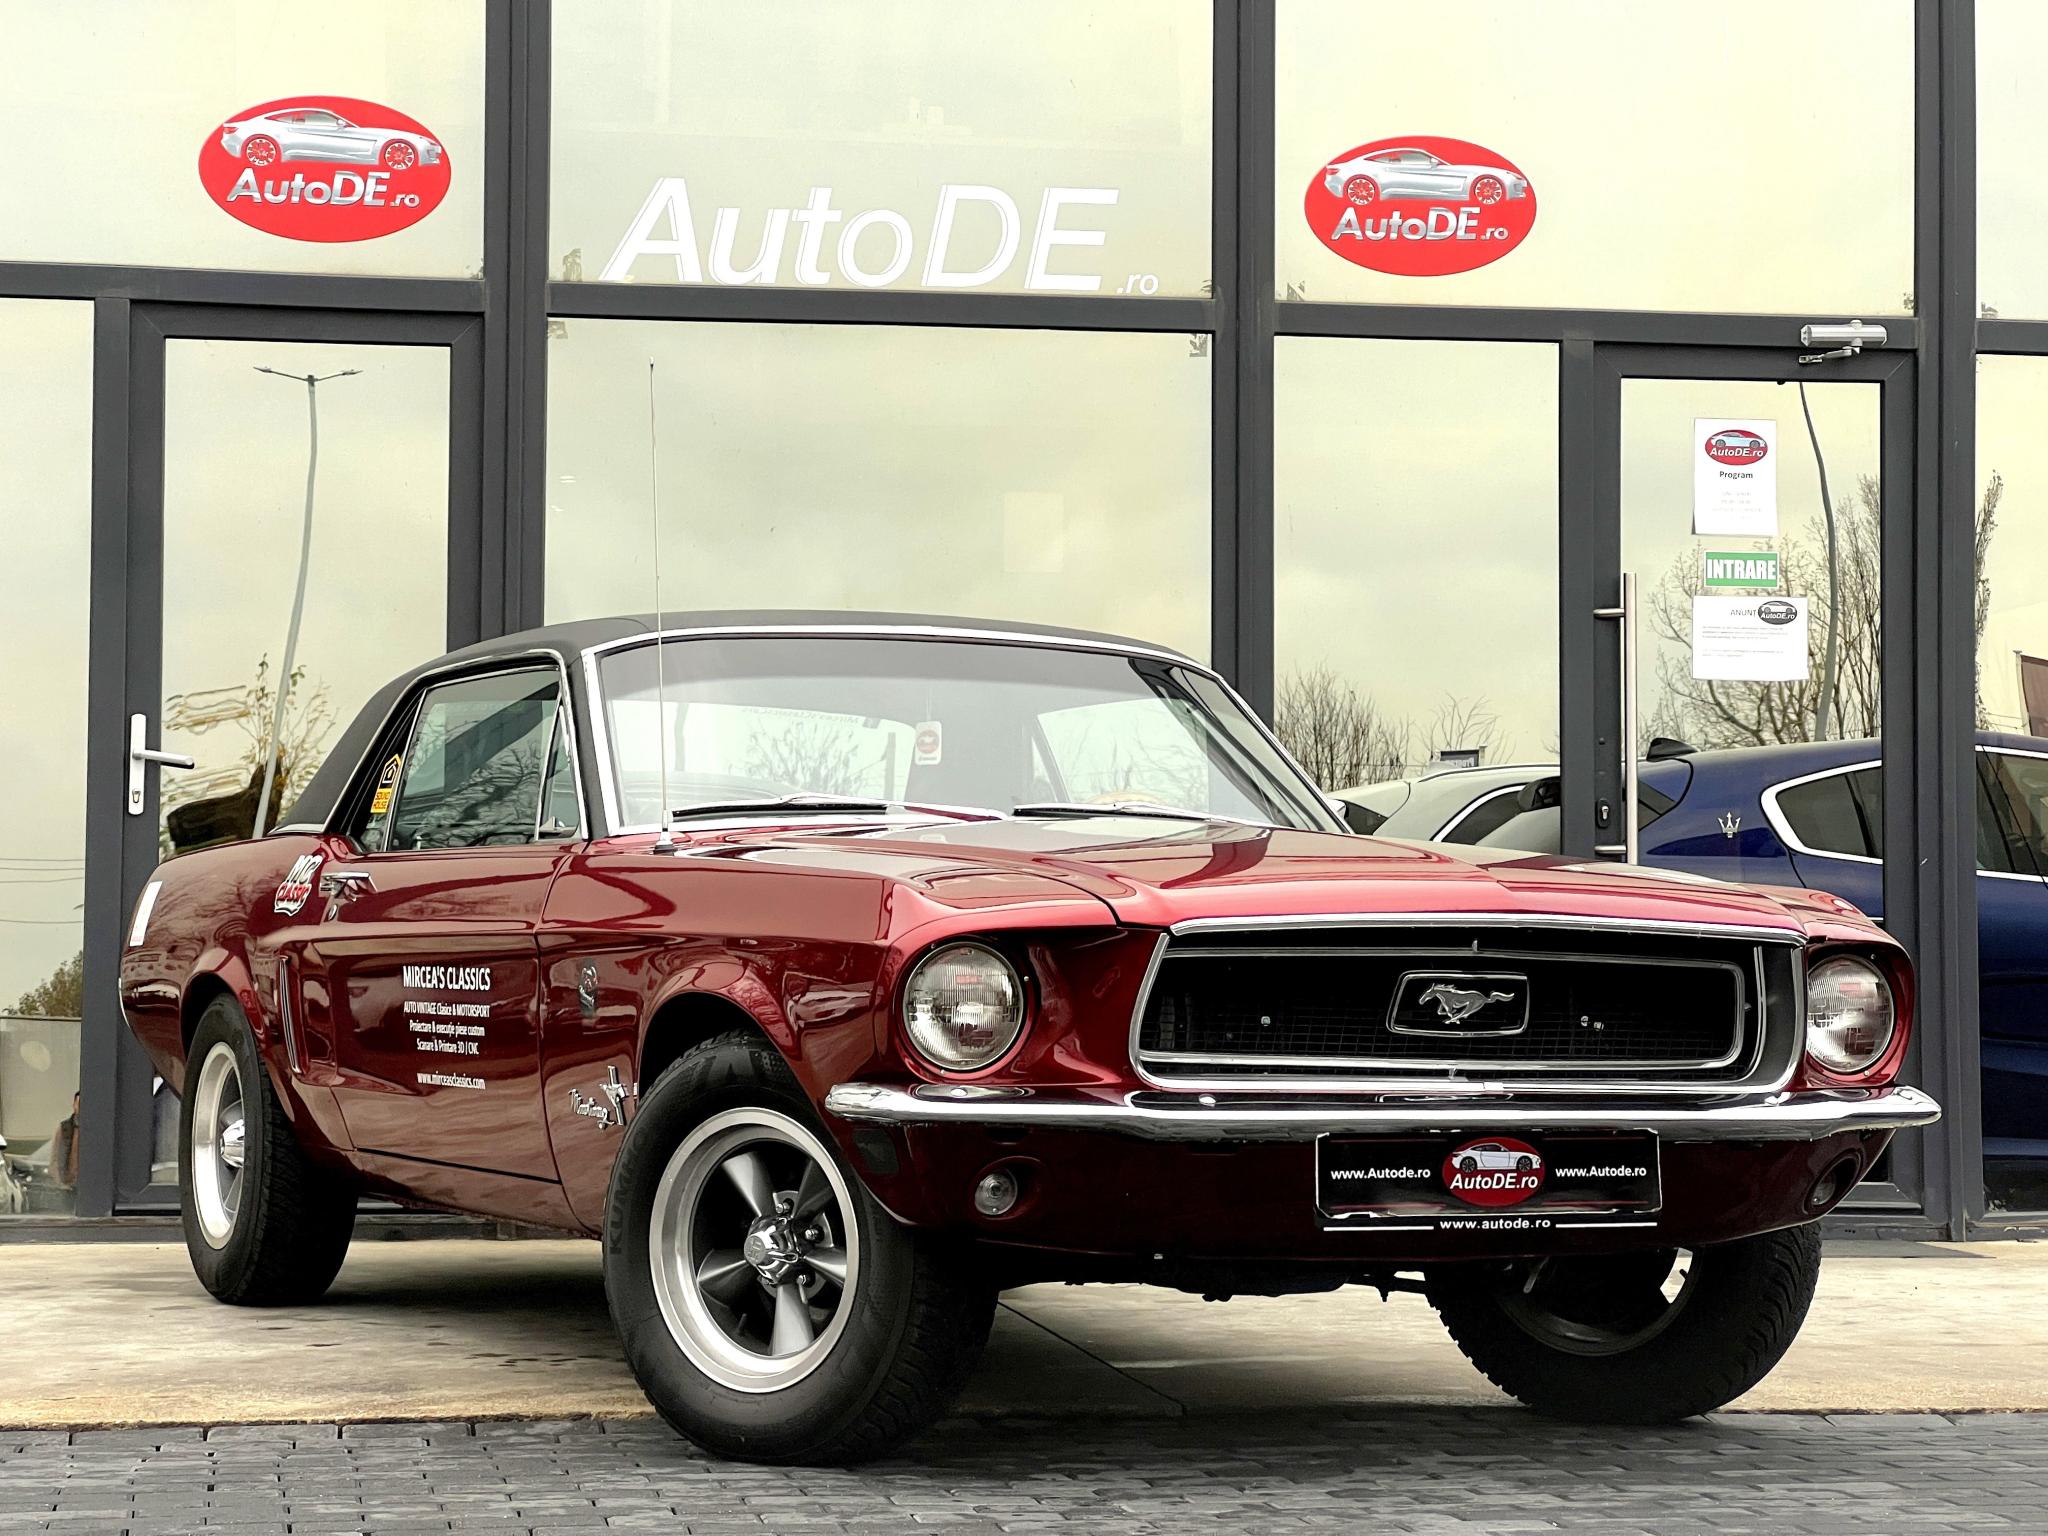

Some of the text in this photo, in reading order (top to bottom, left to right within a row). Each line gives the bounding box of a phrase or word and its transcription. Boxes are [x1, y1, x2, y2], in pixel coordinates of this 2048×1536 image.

[226, 167, 420, 207] AutoDE.ro
[1330, 206, 1509, 241] AutoDE.ro
[1710, 447, 1764, 457] AutoDE.ro
[1719, 470, 1753, 480] Program
[1706, 559, 1777, 580] INTRARE
[1760, 612, 1796, 620] AutoDE.ro
[276, 882, 312, 902] CLASSIC
[403, 965, 491, 990] MIRCEA'S CLASSICS
[404, 1000, 417, 1014] AUTO
[417, 1001, 437, 1015] VINTAGE
[457, 1004, 490, 1018] MOTORSPORT
[1330, 1164, 1648, 1191] www.Autode.ro AutoDE.ro www.Autode.ro
[1439, 1217, 1551, 1230] www.autode.ro
